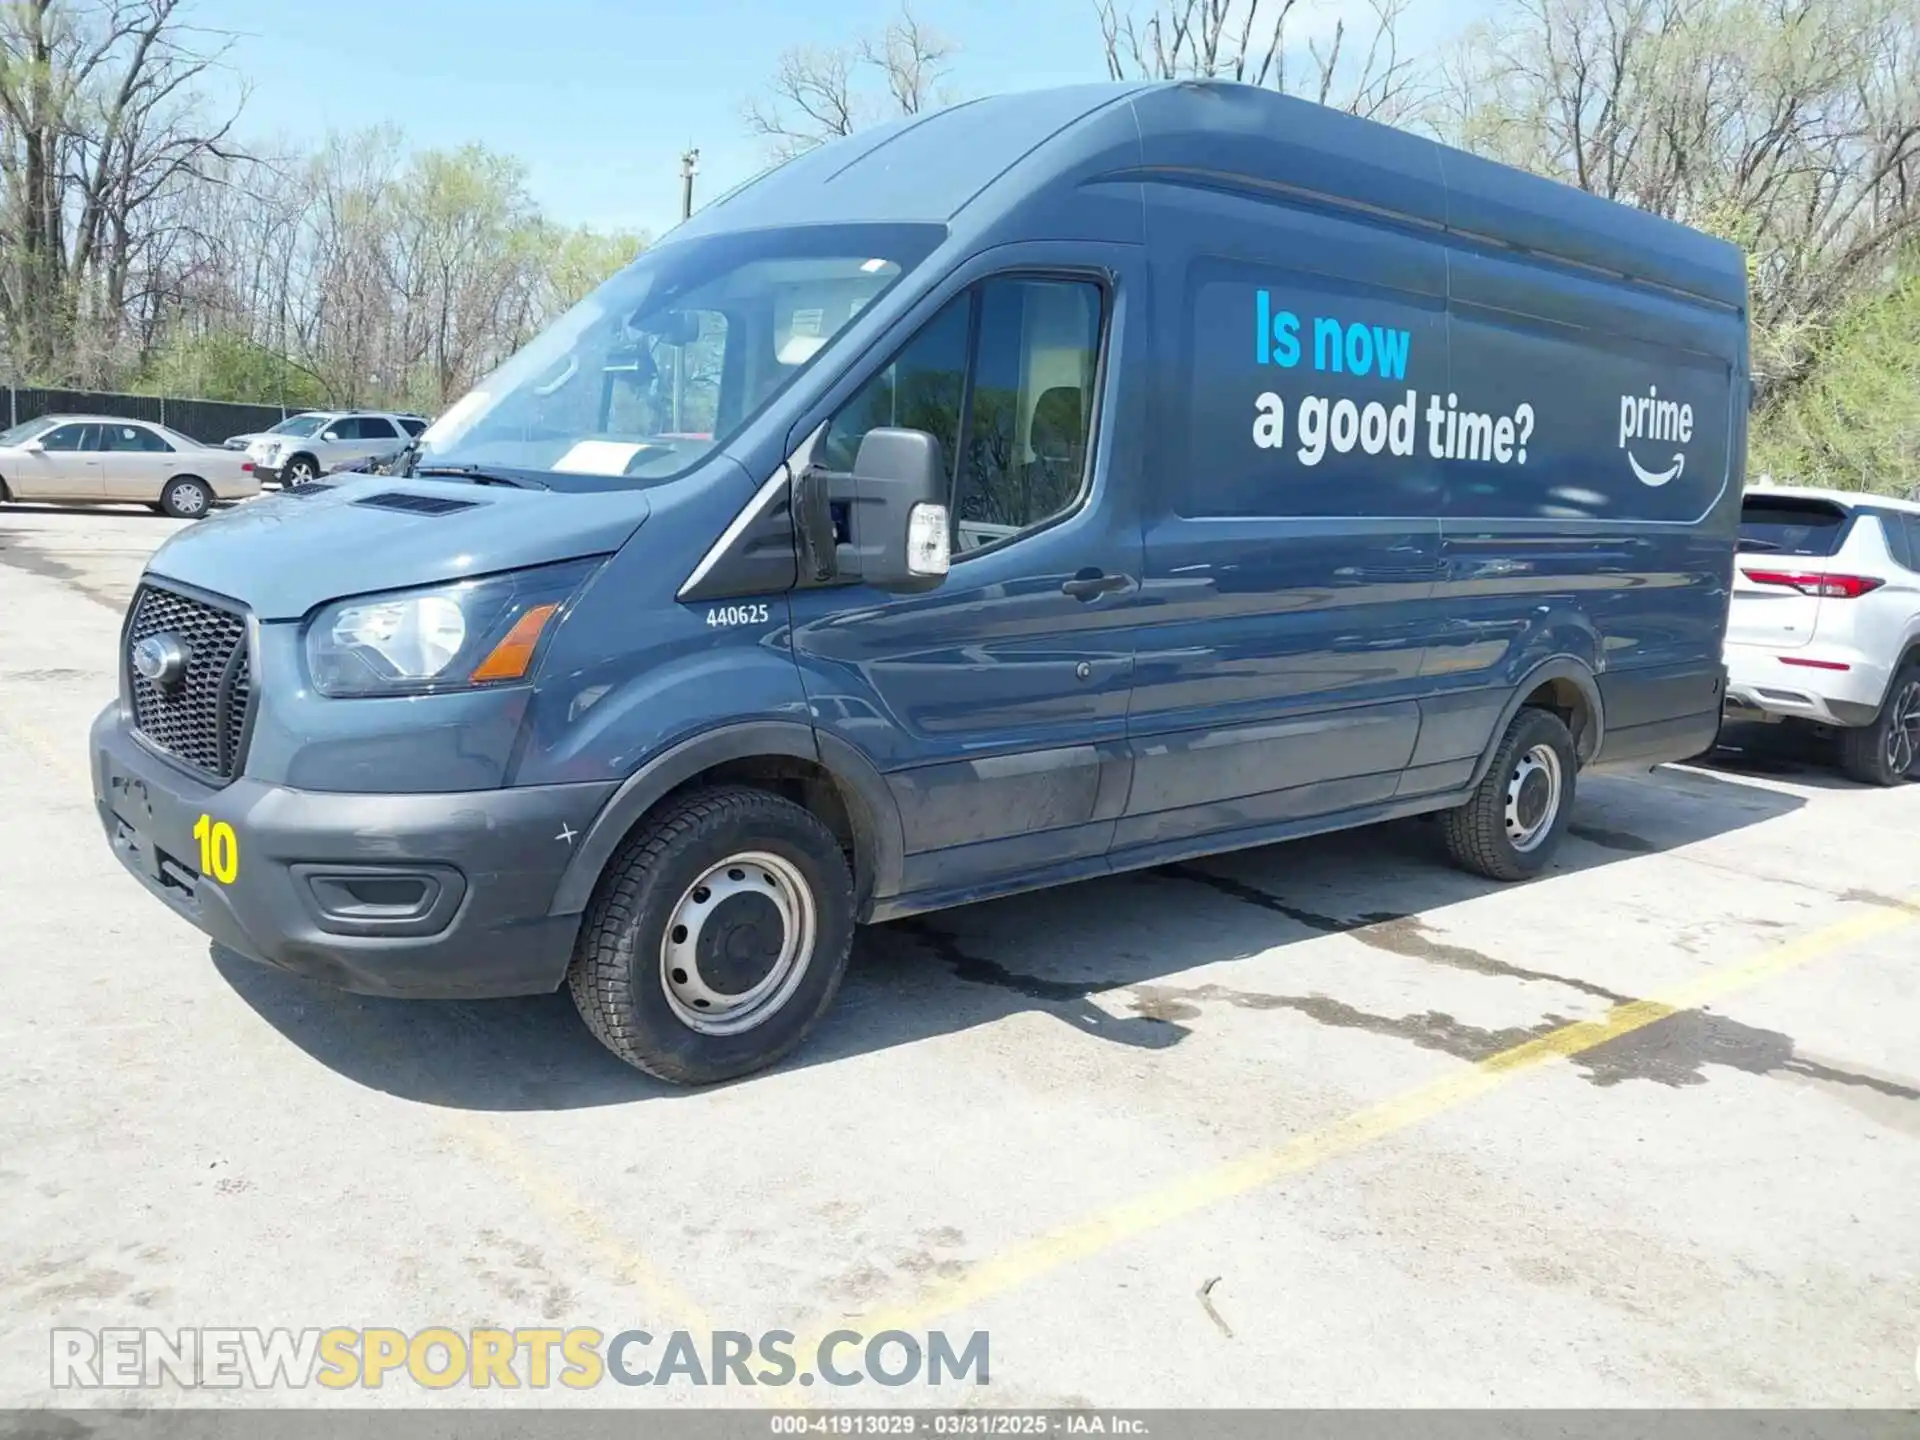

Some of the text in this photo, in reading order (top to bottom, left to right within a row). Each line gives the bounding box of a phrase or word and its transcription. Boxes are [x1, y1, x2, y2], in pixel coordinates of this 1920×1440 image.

[1256, 290, 1411, 381] Is now
[1252, 390, 1535, 467] a good time?
[1619, 385, 1694, 449] prime
[706, 604, 769, 627] 440625
[193, 814, 238, 884] 10
